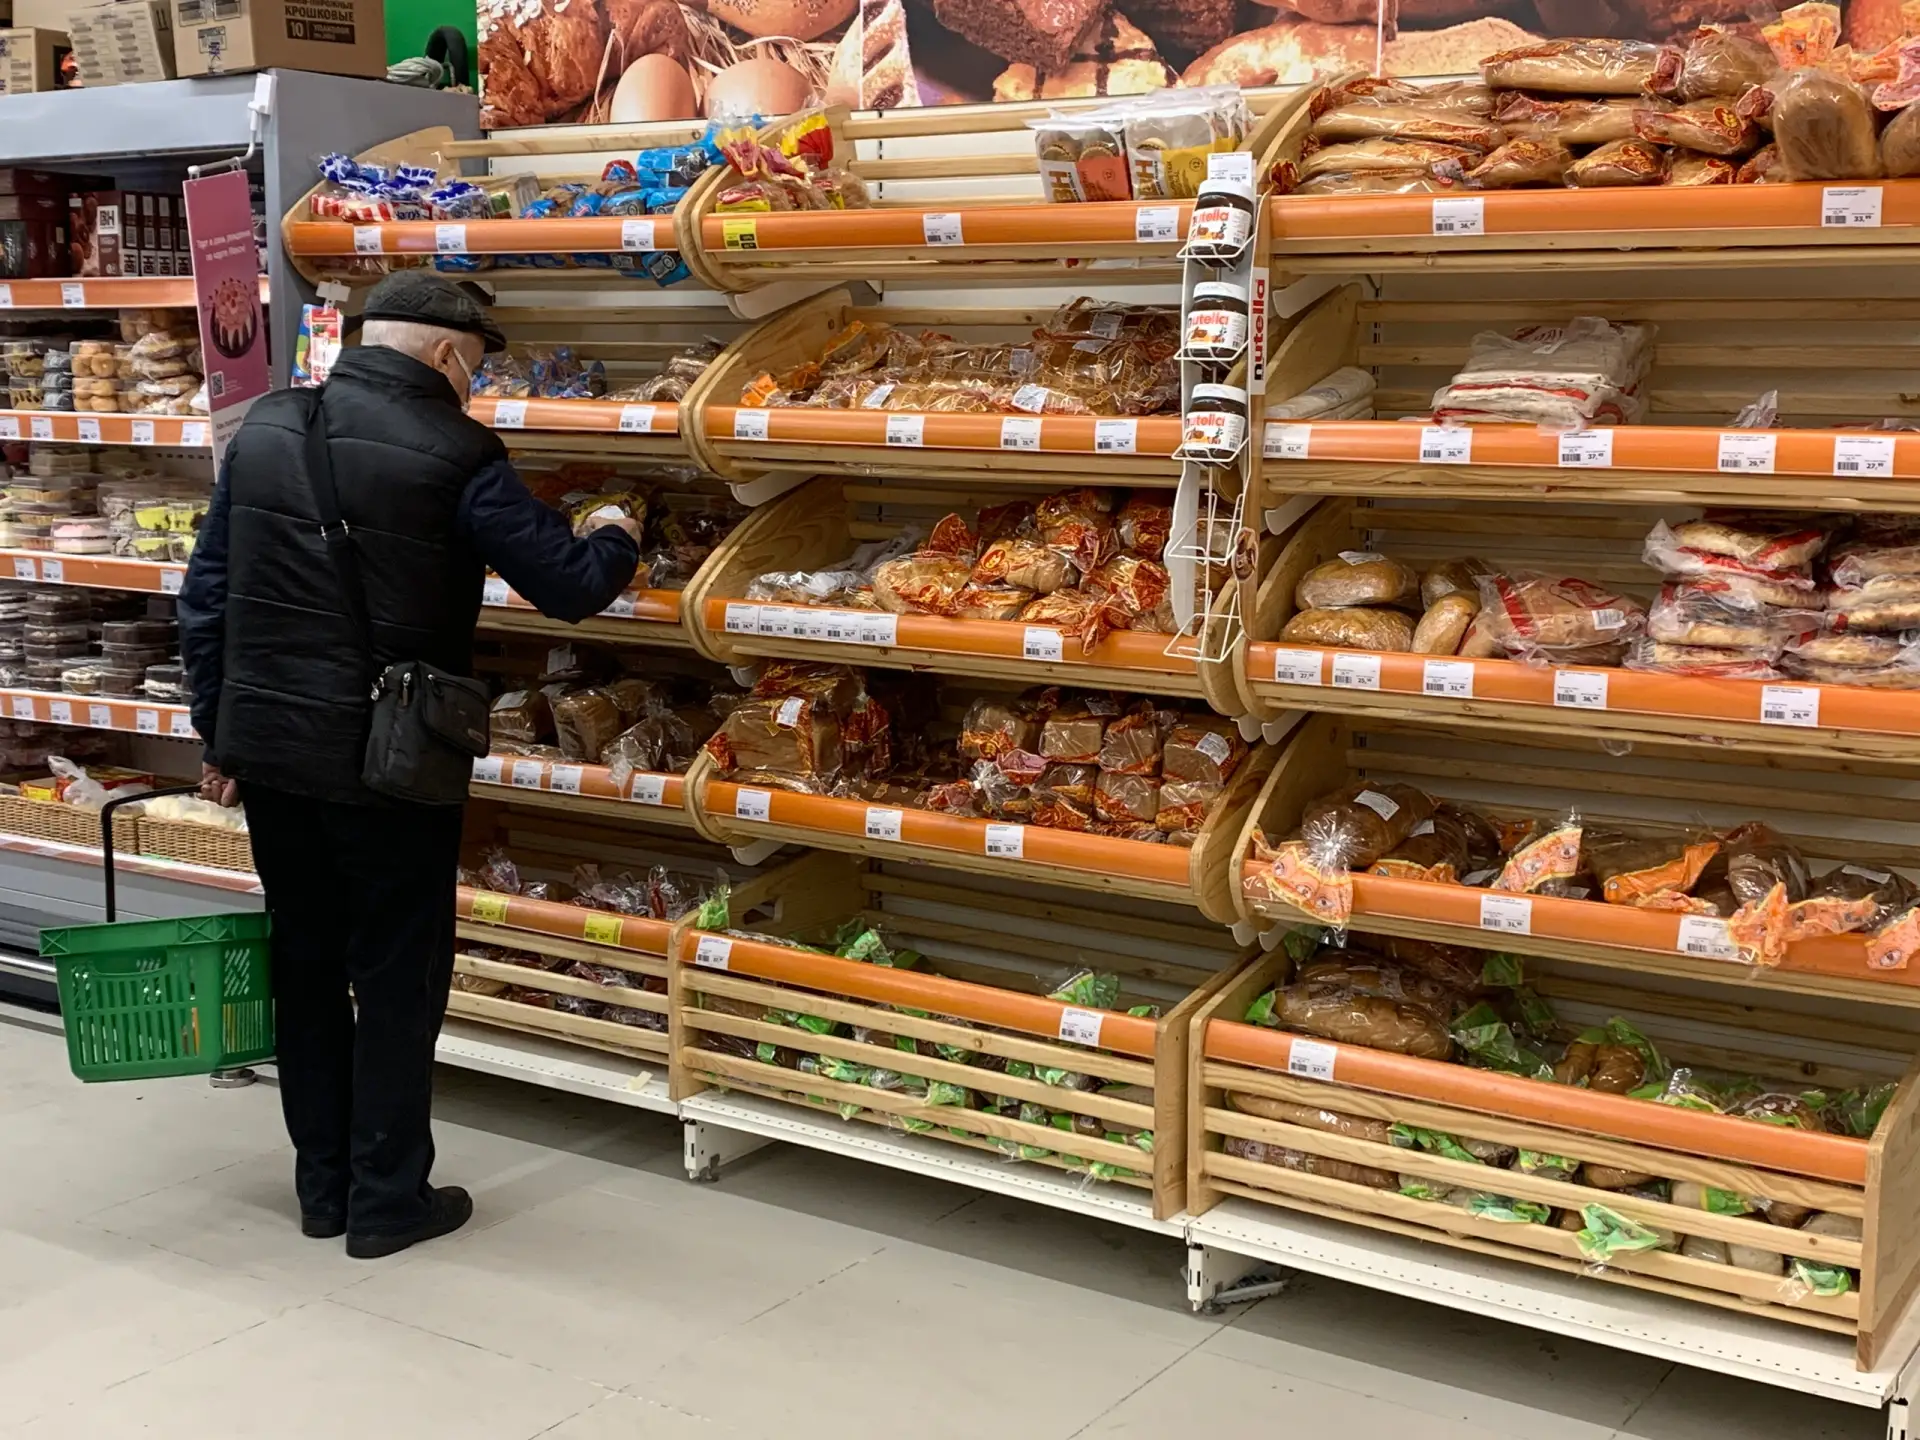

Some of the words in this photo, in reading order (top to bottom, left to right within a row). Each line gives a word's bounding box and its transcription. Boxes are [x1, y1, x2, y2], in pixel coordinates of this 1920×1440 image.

[285, 5, 353, 21] КРОШКОВЫЕ
[291, 21, 304, 37] 10
[1252, 279, 1265, 380] nutella
